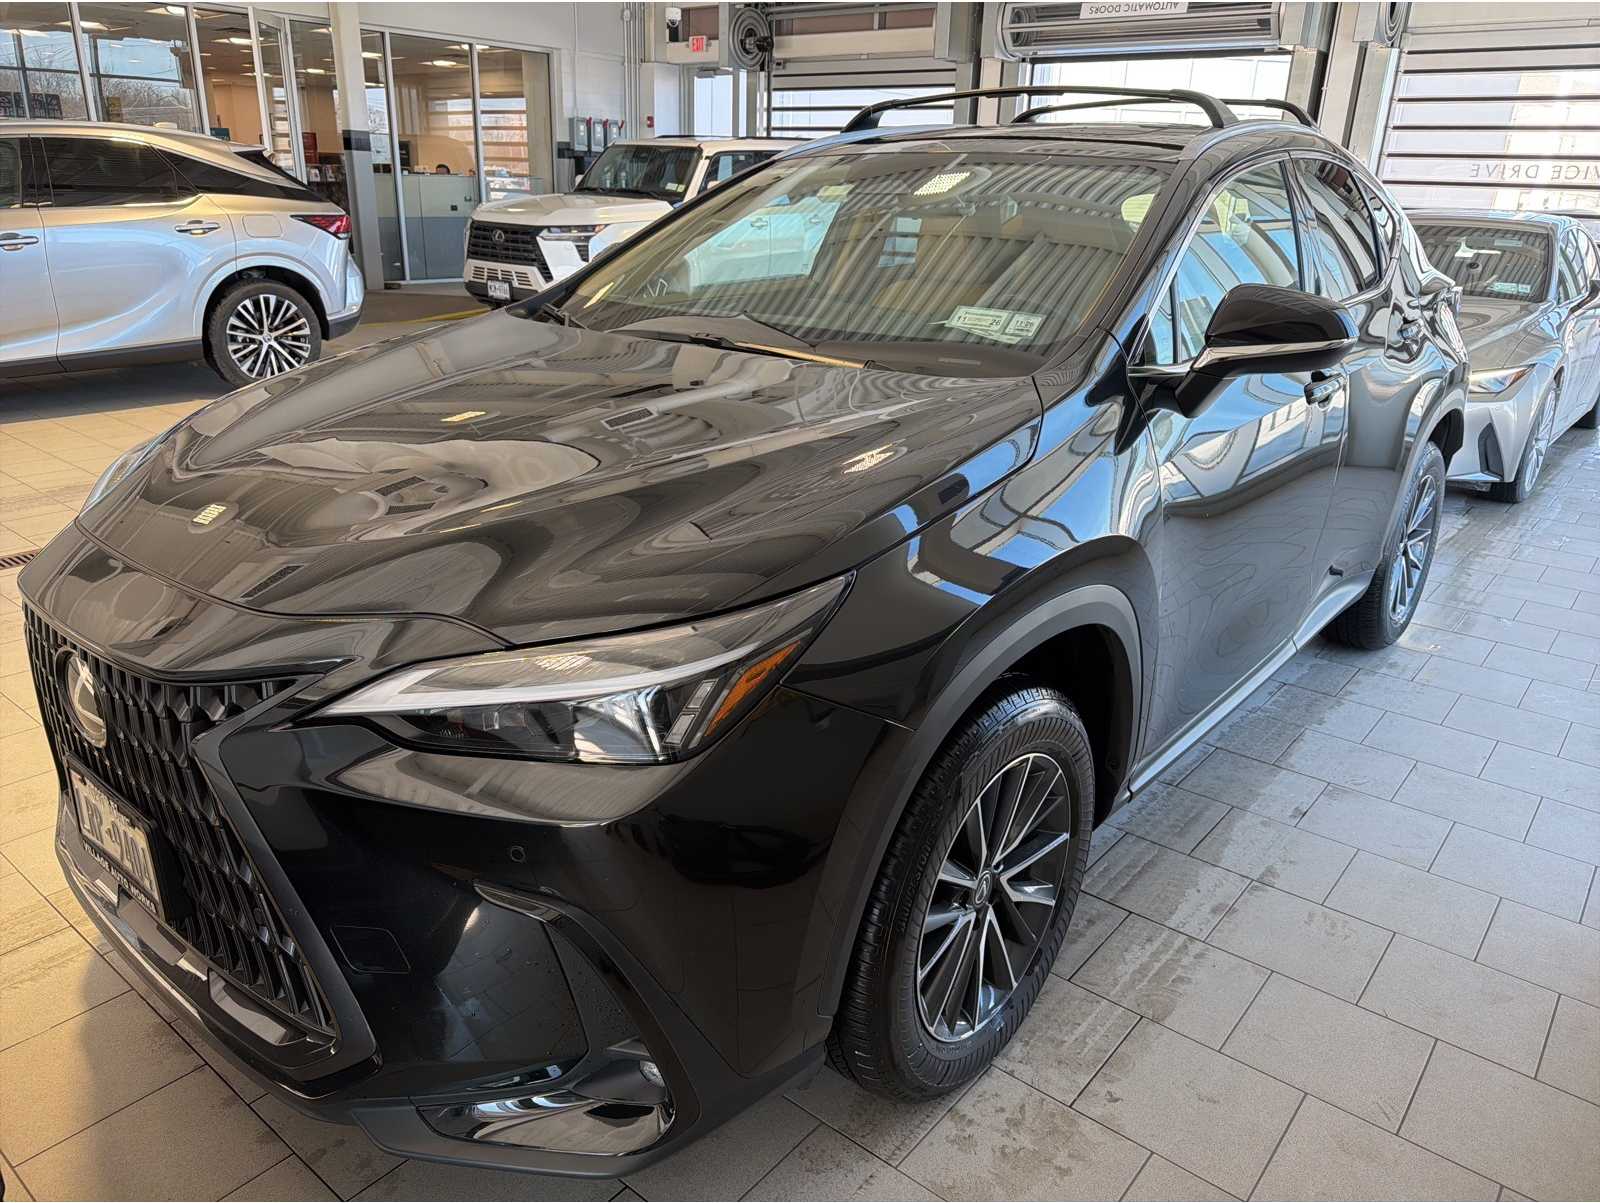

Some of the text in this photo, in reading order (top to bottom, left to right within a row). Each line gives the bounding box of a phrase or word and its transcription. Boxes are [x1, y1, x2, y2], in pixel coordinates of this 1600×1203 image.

[1088, 2, 1179, 15] AUTOMATIC DOORS
[110, 865, 129, 889] AUTO
